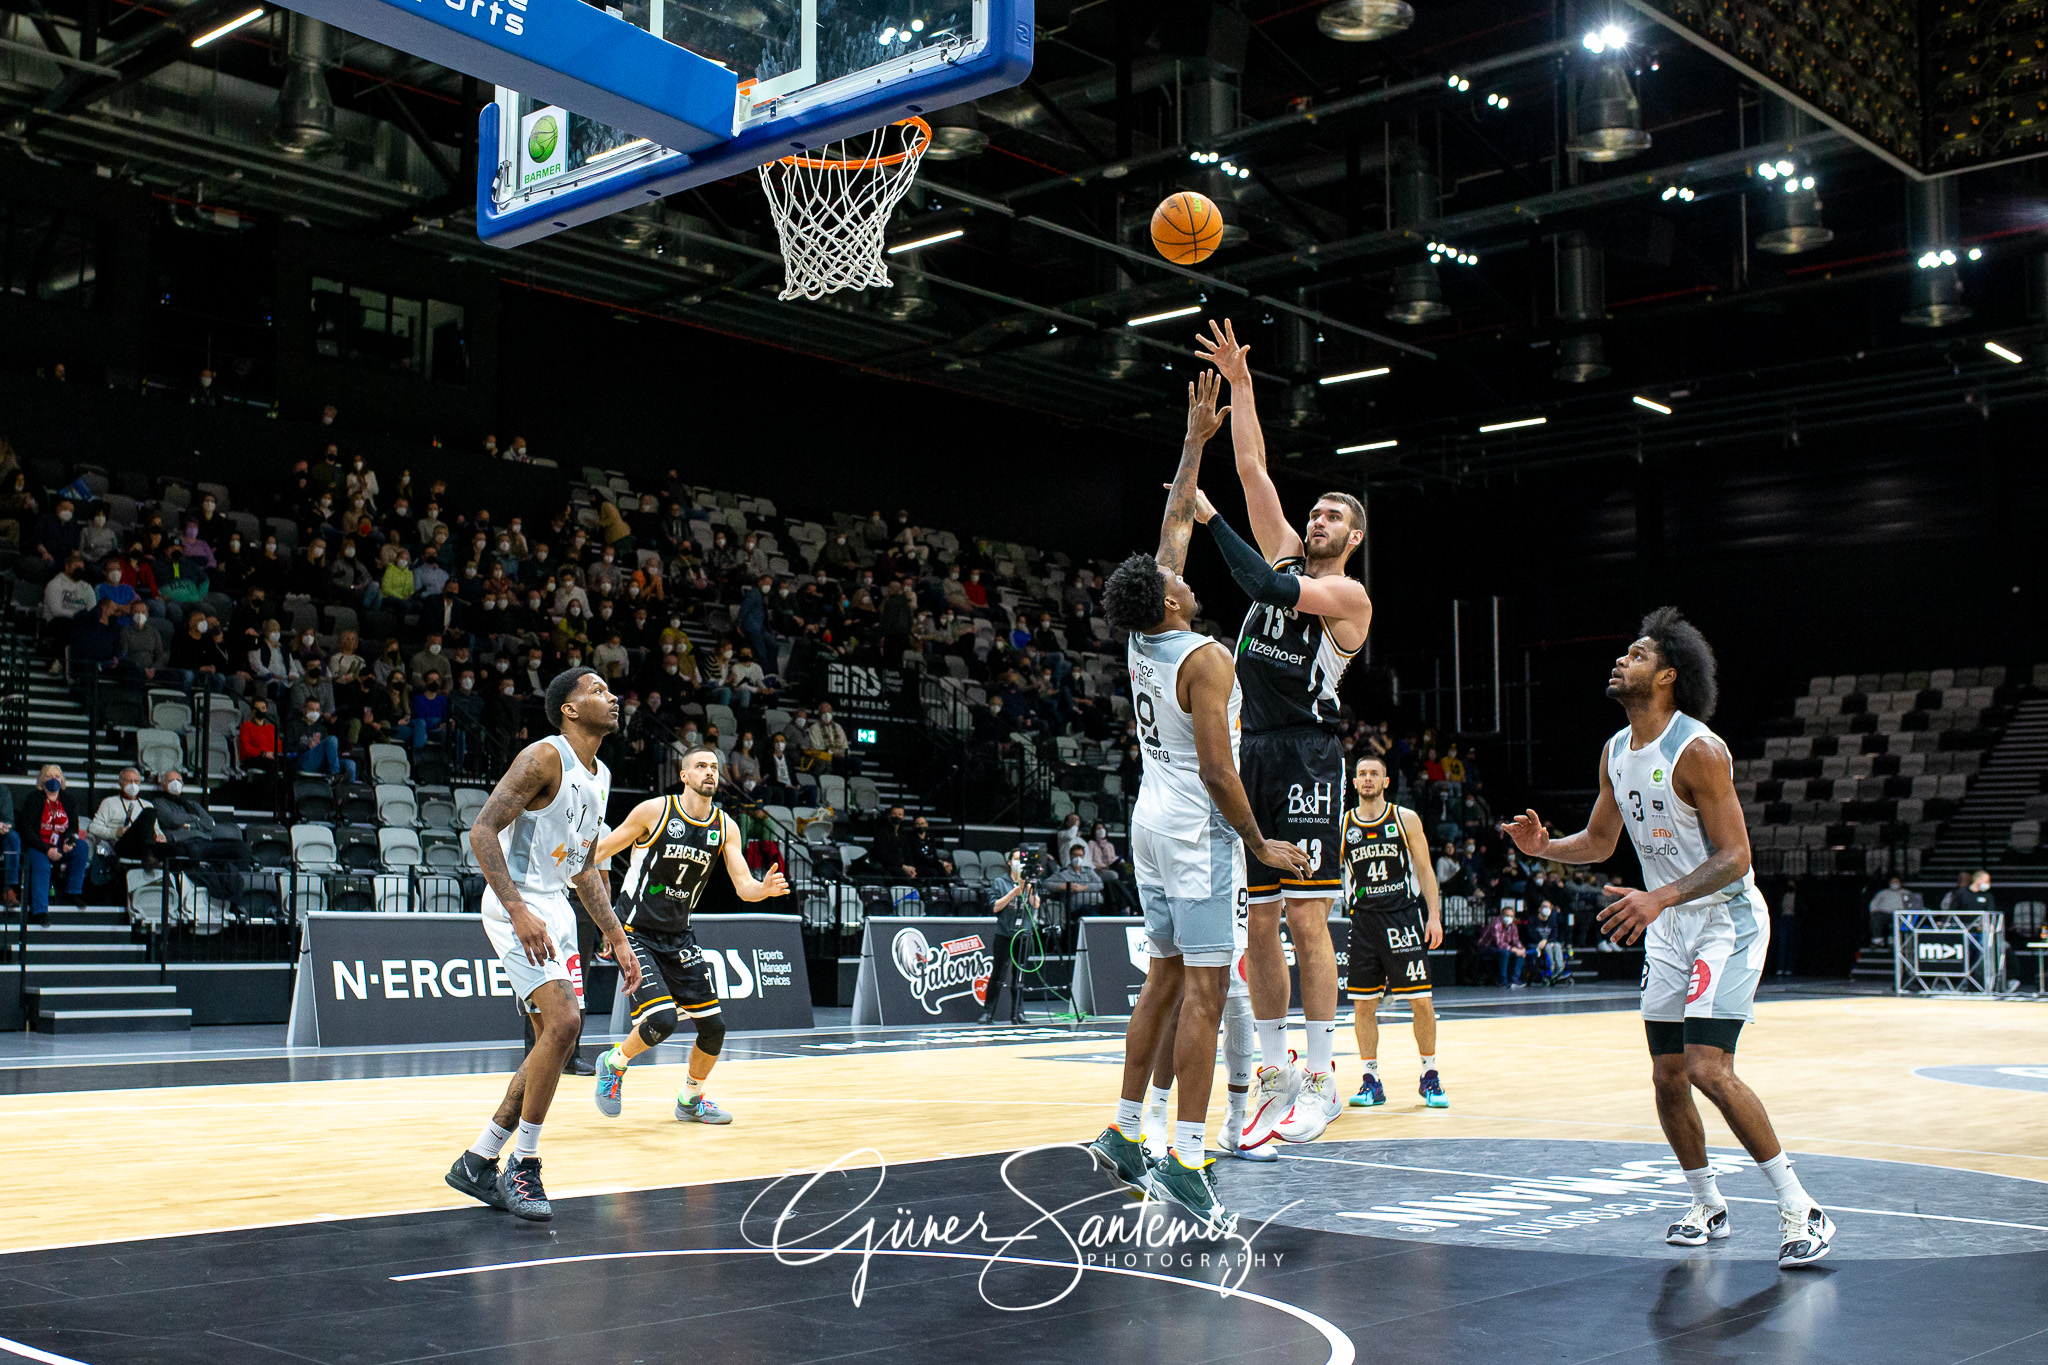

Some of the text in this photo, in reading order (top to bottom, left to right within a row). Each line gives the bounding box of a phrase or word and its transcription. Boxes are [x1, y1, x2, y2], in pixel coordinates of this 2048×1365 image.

[416, 0, 524, 36] orts
[524, 163, 562, 184] BARMER
[1262, 604, 1285, 640] 13
[1248, 637, 1307, 666] Itzehoer
[1287, 782, 1332, 815] B&H
[1628, 789, 1645, 822] 3
[662, 843, 712, 866] EAGLES
[1296, 838, 1322, 871] 13
[1350, 843, 1399, 864] EAGLES
[675, 863, 690, 885] 7
[1366, 860, 1388, 882] 44
[1365, 881, 1405, 895] Itzehoer
[1386, 925, 1421, 949] B&H
[758, 949, 784, 961] Experts
[760, 962, 792, 975] Managed
[912, 947, 993, 996] Falcons
[1405, 959, 1427, 982] 44
[762, 975, 792, 987] Services
